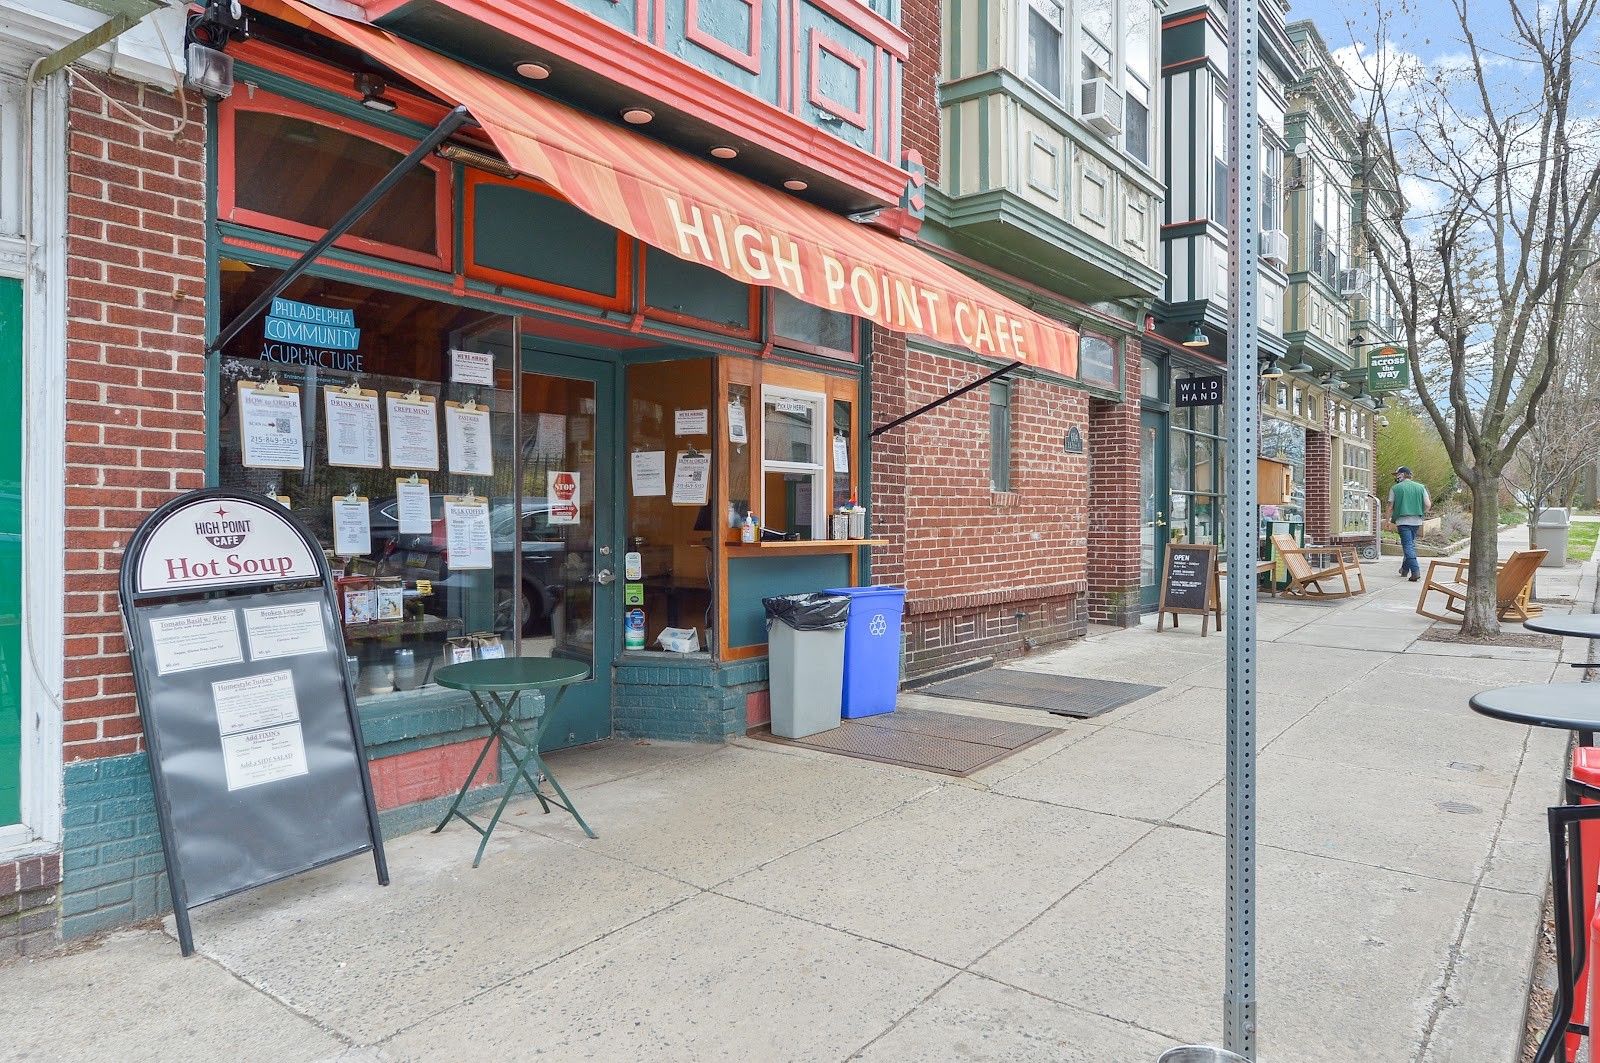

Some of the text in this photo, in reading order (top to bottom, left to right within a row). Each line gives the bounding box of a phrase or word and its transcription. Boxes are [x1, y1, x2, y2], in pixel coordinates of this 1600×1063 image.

[670, 199, 1027, 359] HIGH POINT CAFE
[275, 301, 351, 326] PHILADELPHIA
[267, 320, 358, 348] COMMUNITY
[260, 343, 363, 372] ACUPUNCTURE
[1371, 358, 1405, 366] across
[1181, 381, 1218, 391] WILD
[1181, 392, 1218, 402] HAND
[331, 400, 353, 408] DRINK
[250, 436, 298, 444] 215-849-5153
[195, 520, 251, 535] HIGH POINT
[213, 536, 239, 546] CAFE
[165, 554, 293, 580] Hot Soup
[160, 620, 185, 628] Tomato
[218, 680, 251, 691] Homestyle
[252, 677, 272, 686] Turkey
